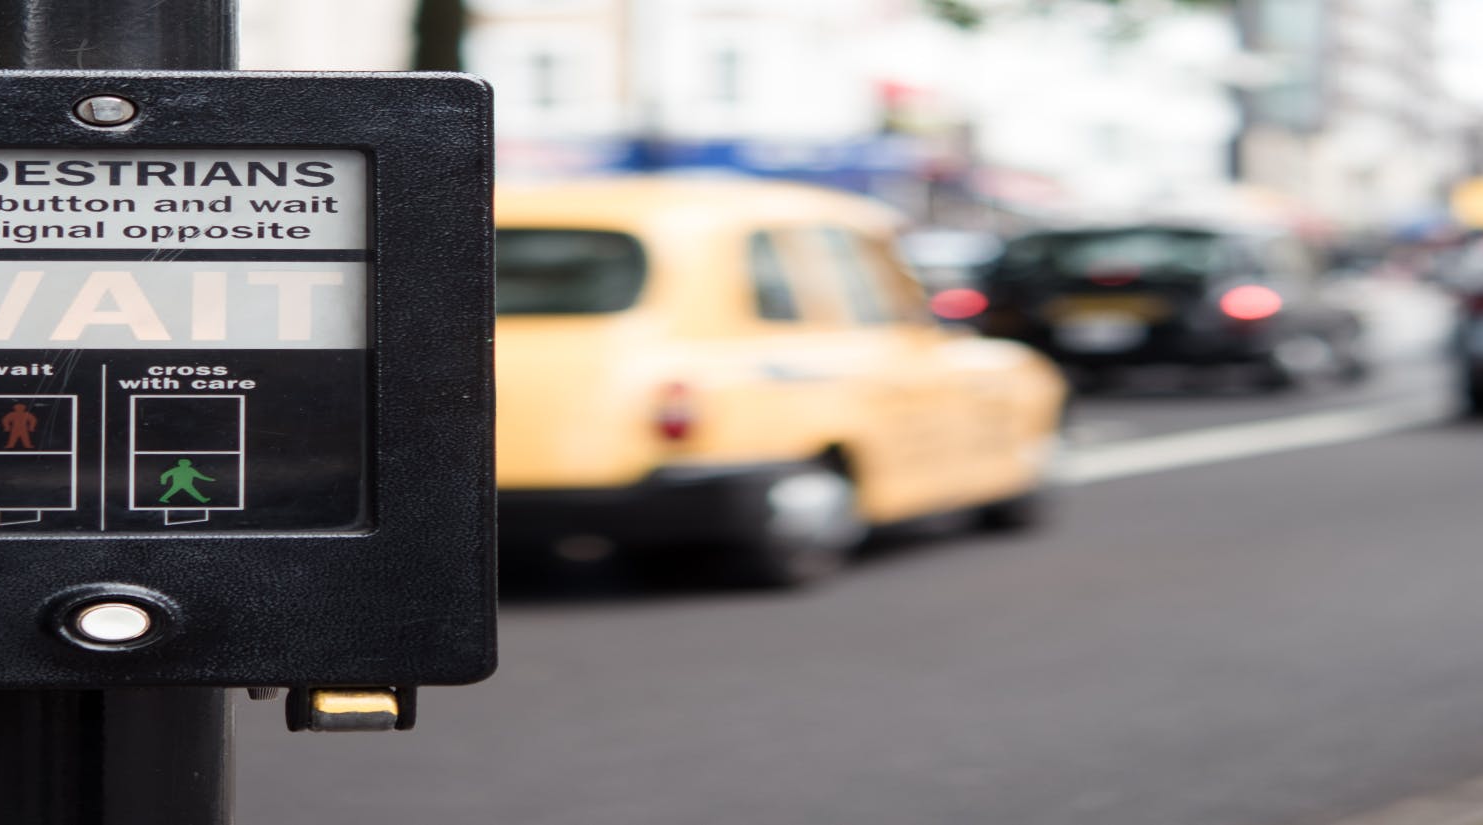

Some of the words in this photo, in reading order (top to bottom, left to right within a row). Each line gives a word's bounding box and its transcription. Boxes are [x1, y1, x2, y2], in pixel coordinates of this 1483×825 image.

[155, 196, 231, 212] and
[250, 196, 338, 213] wait
[124, 222, 310, 242] opposite
[148, 366, 227, 375] cross
[120, 378, 179, 389] with
[192, 380, 255, 389] care
